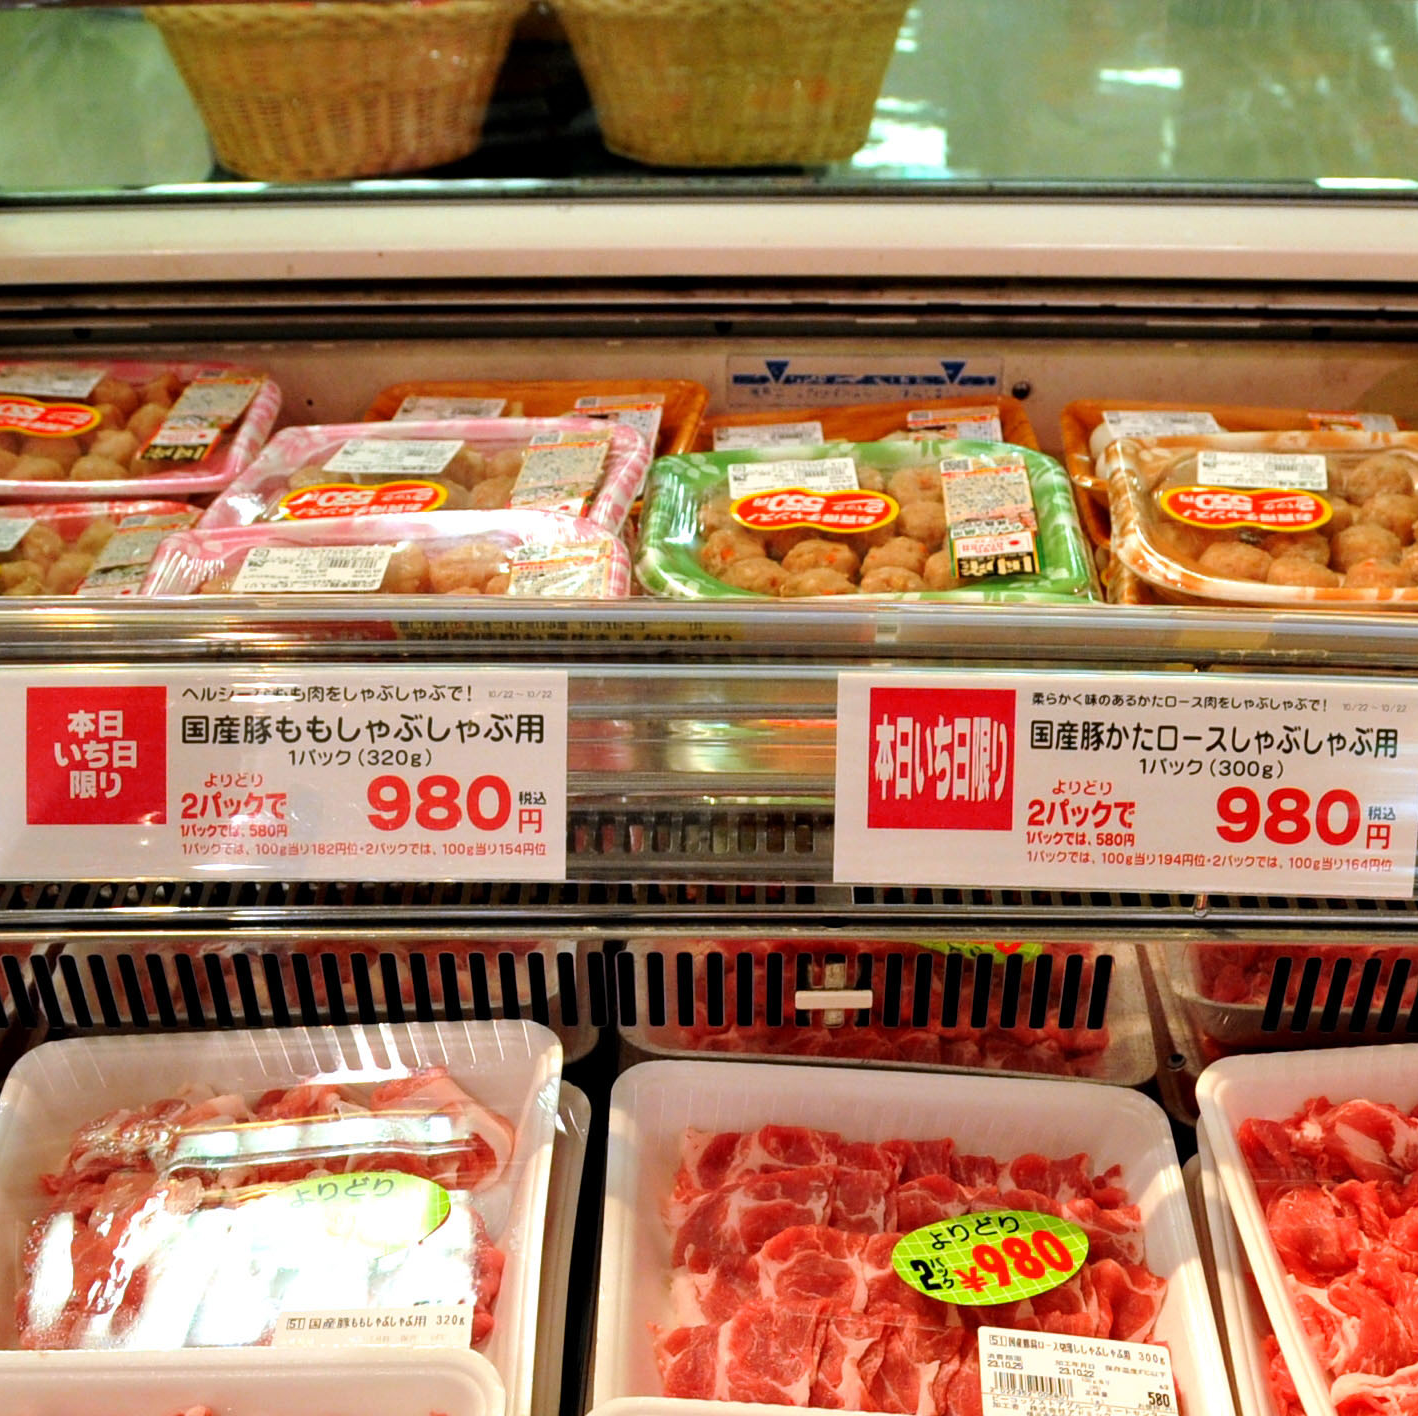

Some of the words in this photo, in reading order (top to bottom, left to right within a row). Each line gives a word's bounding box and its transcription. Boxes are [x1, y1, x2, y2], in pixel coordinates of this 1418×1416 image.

[67, 710, 123, 738] 本日
[181, 715, 545, 744] 国産豚ももしゃぶしゃぶ用
[1031, 720, 1398, 758] 国産豚かたロースしゃぶしゃぶ用
[53, 741, 137, 768] いち日
[873, 715, 1009, 803] 本日いち日限り
[70, 771, 122, 799] 限り
[204, 773, 263, 788] よりどり
[1052, 780, 1112, 795] よりどり
[181, 792, 287, 820] 2パックで
[519, 792, 546, 805] 税込
[1027, 800, 1136, 828] 2パックで
[1368, 806, 1395, 821] 税込
[931, 1216, 1020, 1251] よりどり
[1148, 1392, 1170, 1407] 580
